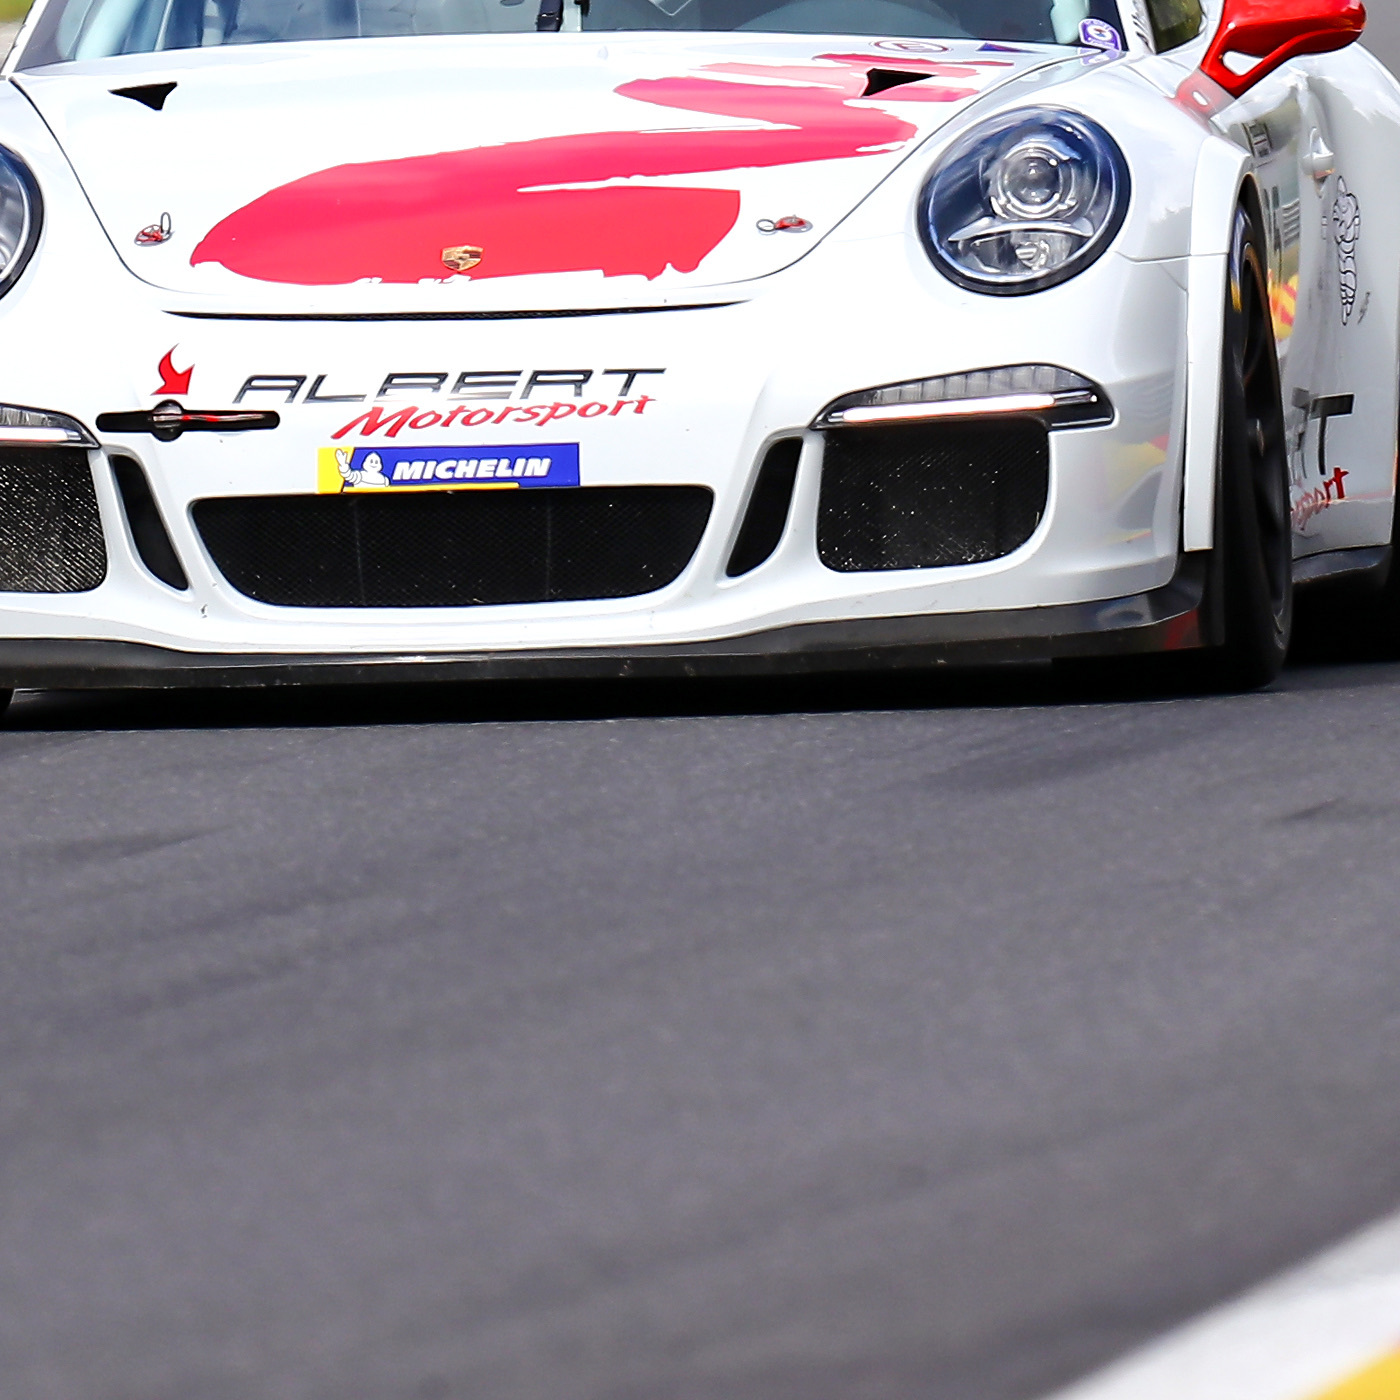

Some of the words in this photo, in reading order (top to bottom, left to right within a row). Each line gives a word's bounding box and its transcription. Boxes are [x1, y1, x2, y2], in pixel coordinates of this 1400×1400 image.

[232, 367, 667, 404] ALBERT
[330, 394, 656, 440] Motorsport
[392, 457, 552, 481] MICHELIN
